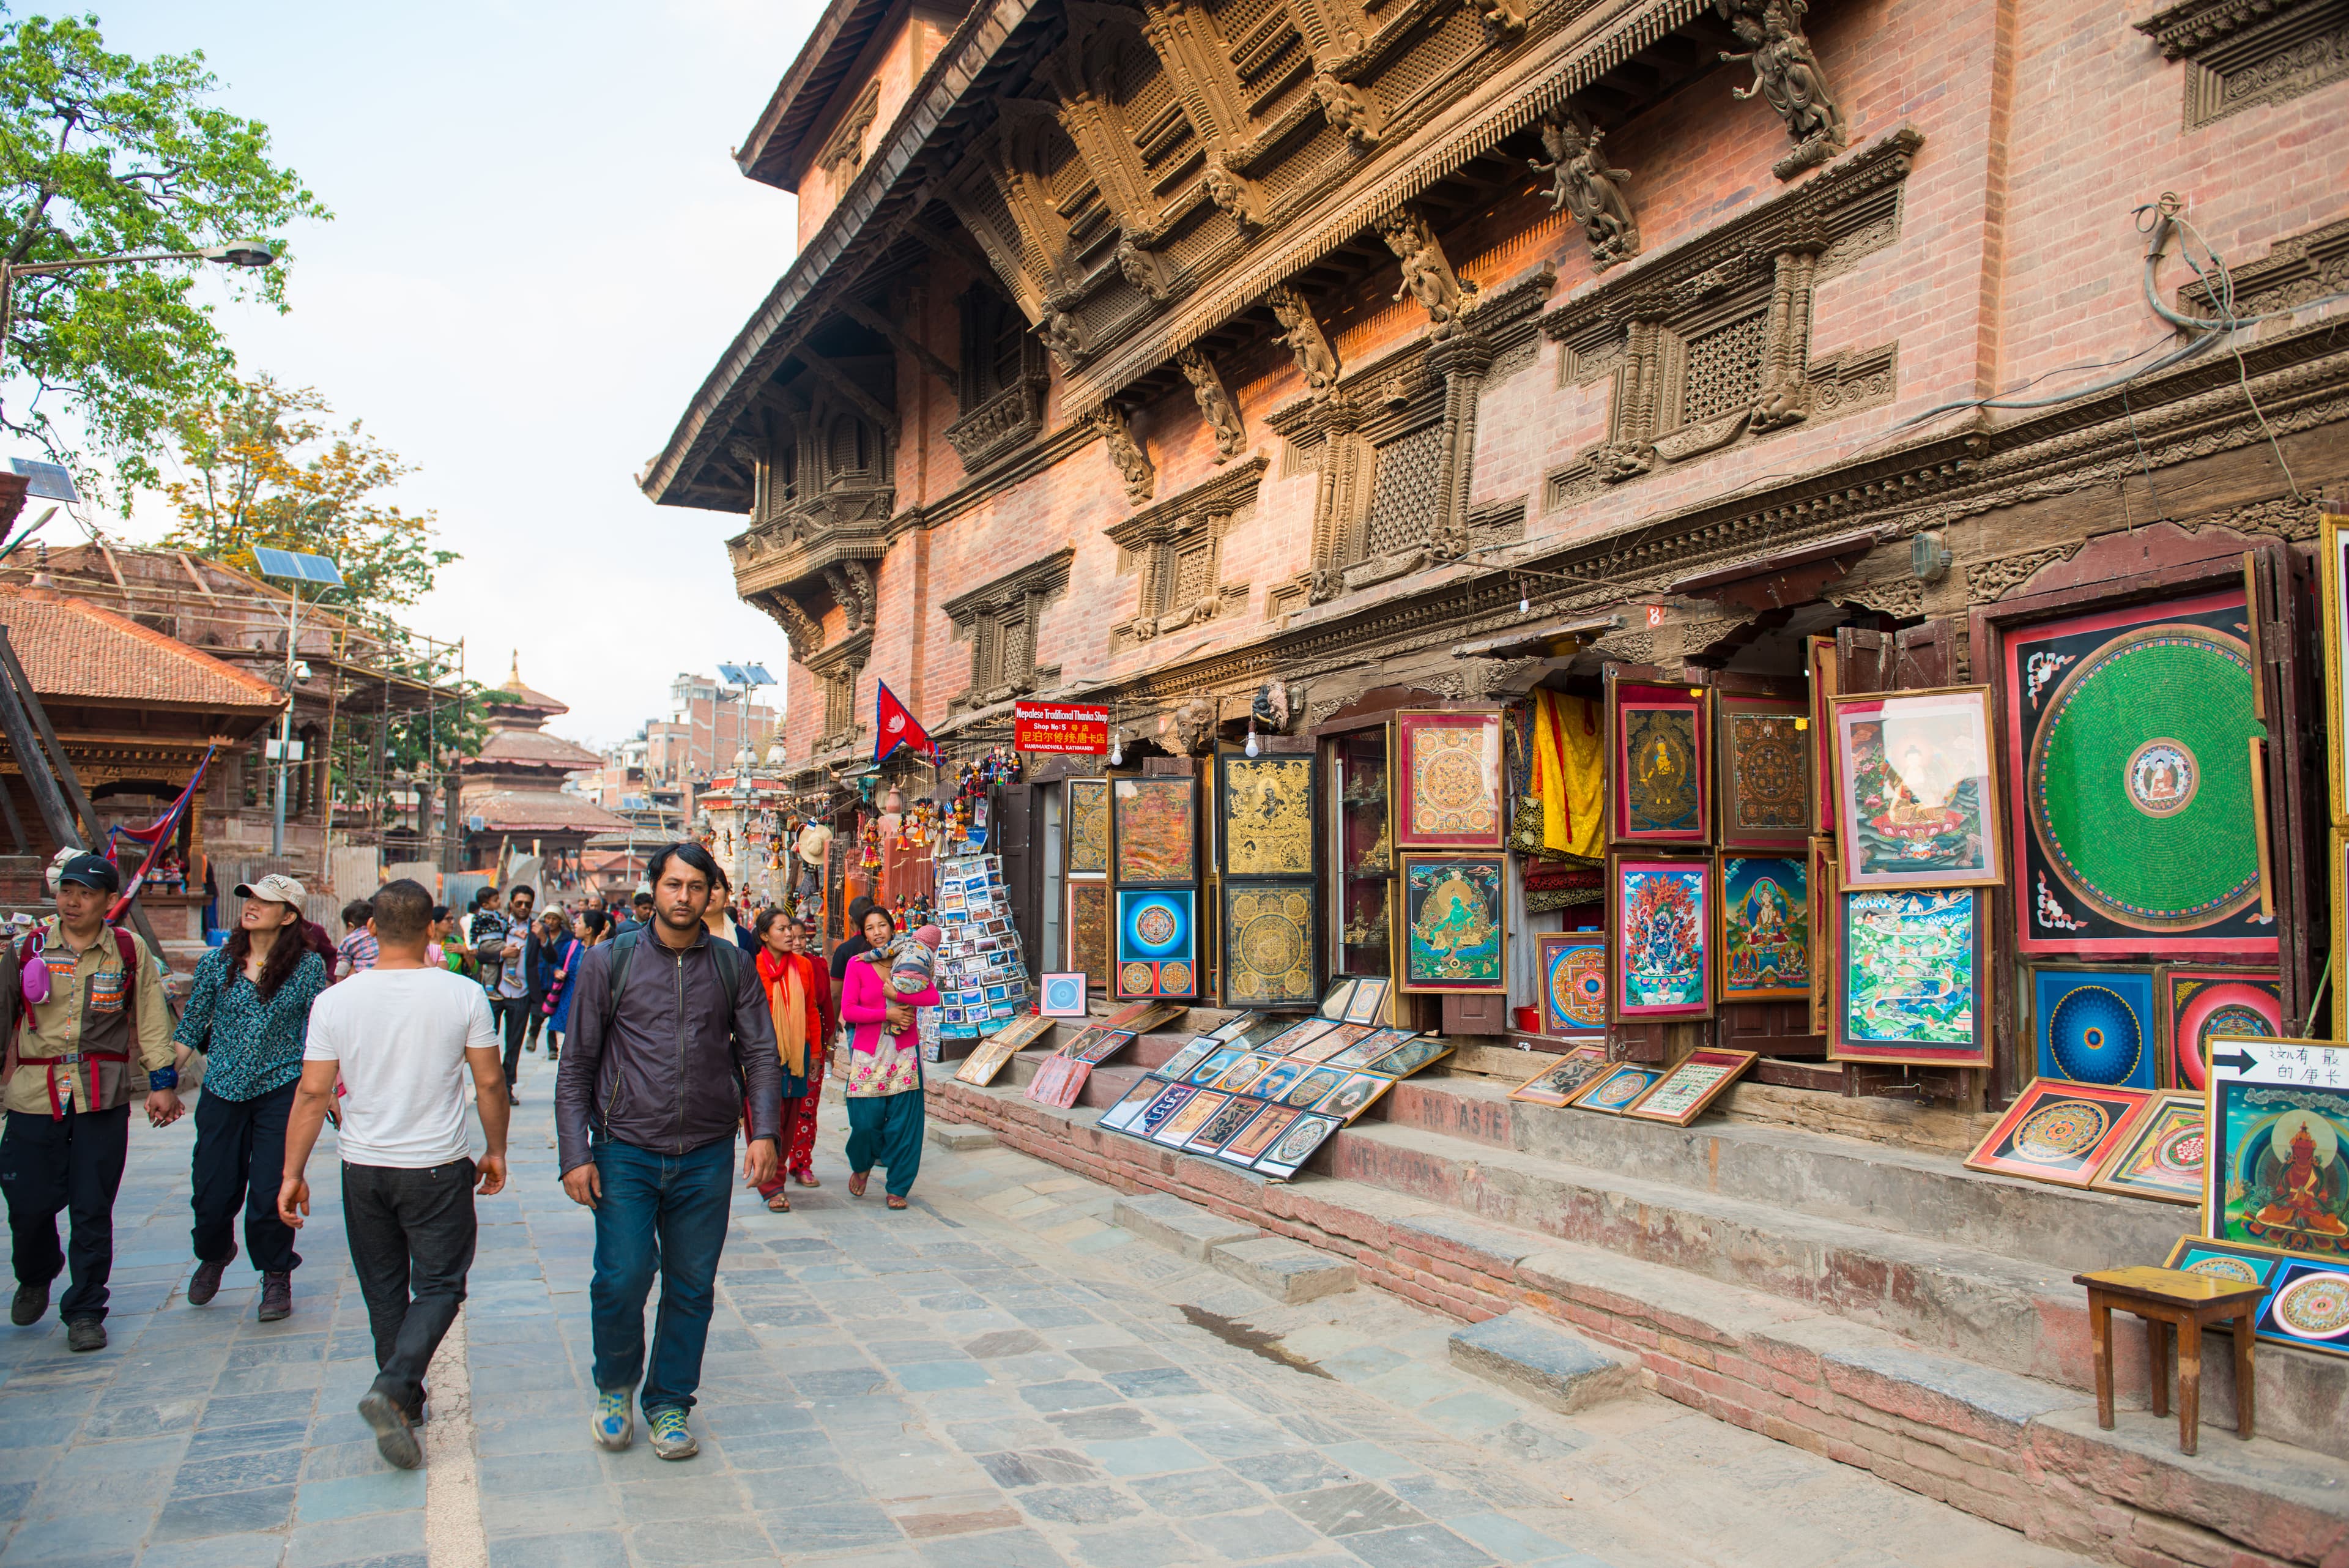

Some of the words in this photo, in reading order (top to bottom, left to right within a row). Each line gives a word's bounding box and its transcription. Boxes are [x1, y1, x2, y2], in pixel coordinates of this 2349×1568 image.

[1016, 707, 1044, 721] Nepalese
[1044, 708, 1074, 720] Traditional
[1074, 710, 1094, 721] Thanka
[1094, 711, 1108, 724] Shop
[1033, 723, 1049, 731] Shop
[1021, 731, 1105, 745] 尼泊尔传统唐卡店
[1423, 1096, 1502, 1141] NAASTE
